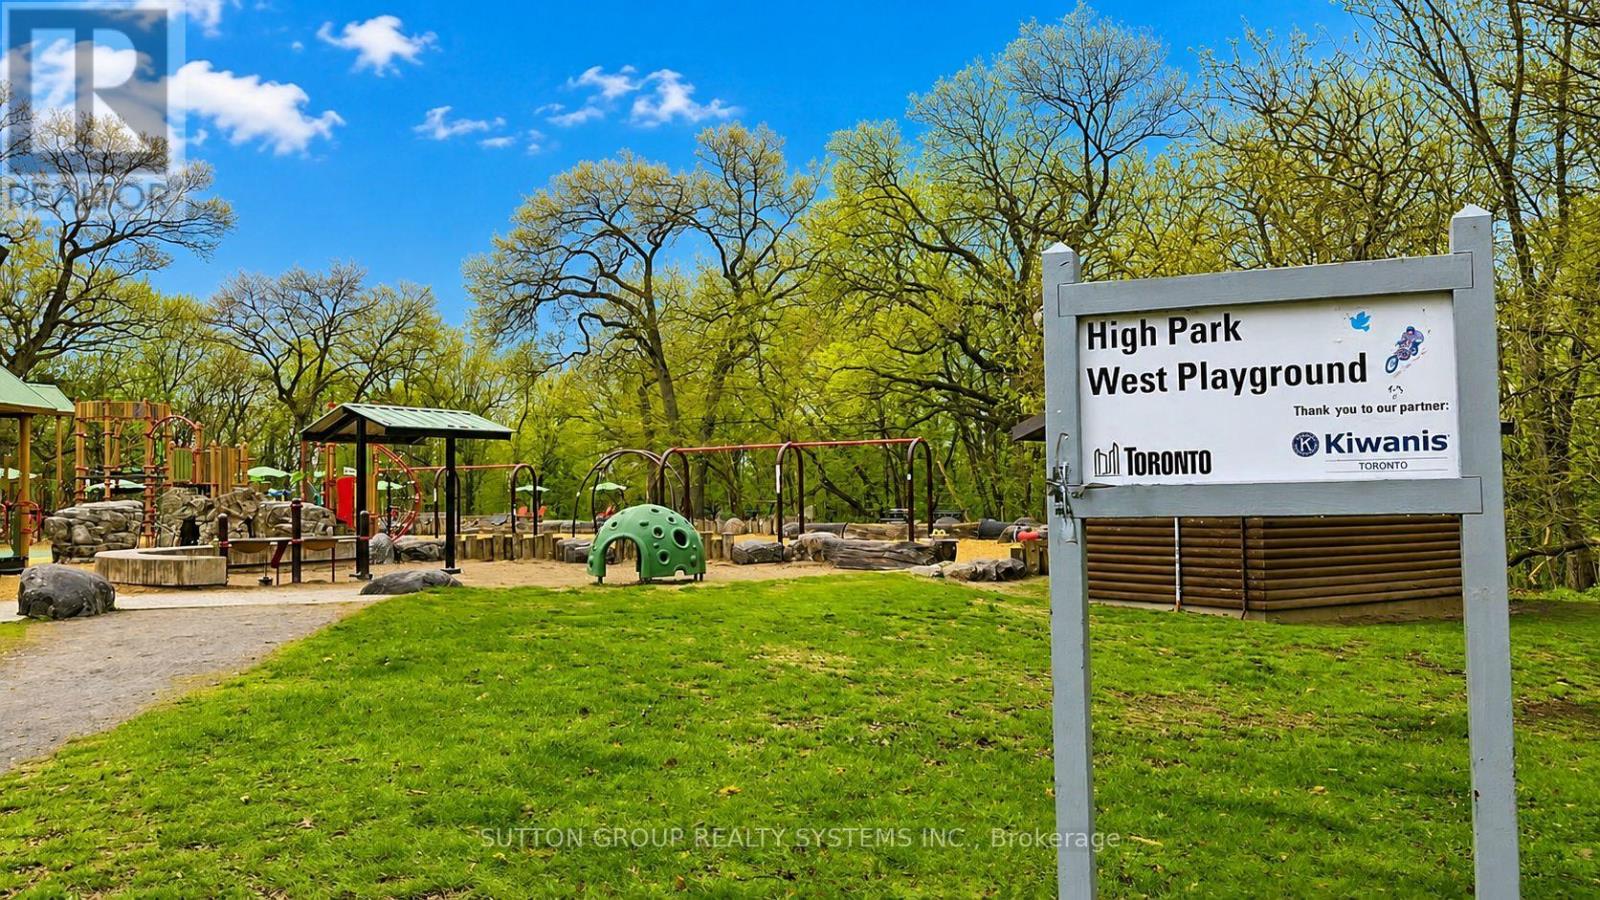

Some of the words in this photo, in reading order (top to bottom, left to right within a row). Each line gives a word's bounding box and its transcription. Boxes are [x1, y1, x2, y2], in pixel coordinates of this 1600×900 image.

[1087, 318, 1157, 355] High
[1168, 312, 1243, 346] Park
[1086, 366, 1168, 396] West
[1177, 352, 1368, 396] Playground
[1293, 405, 1330, 416] Thank
[1335, 406, 1357, 417] you
[1361, 404, 1373, 414] to
[1376, 403, 1397, 413] our
[1399, 401, 1450, 415] partner:
[1325, 430, 1449, 454] Kiwanis
[1123, 447, 1212, 476] TORONTO
[1358, 461, 1408, 471] TORONTO
